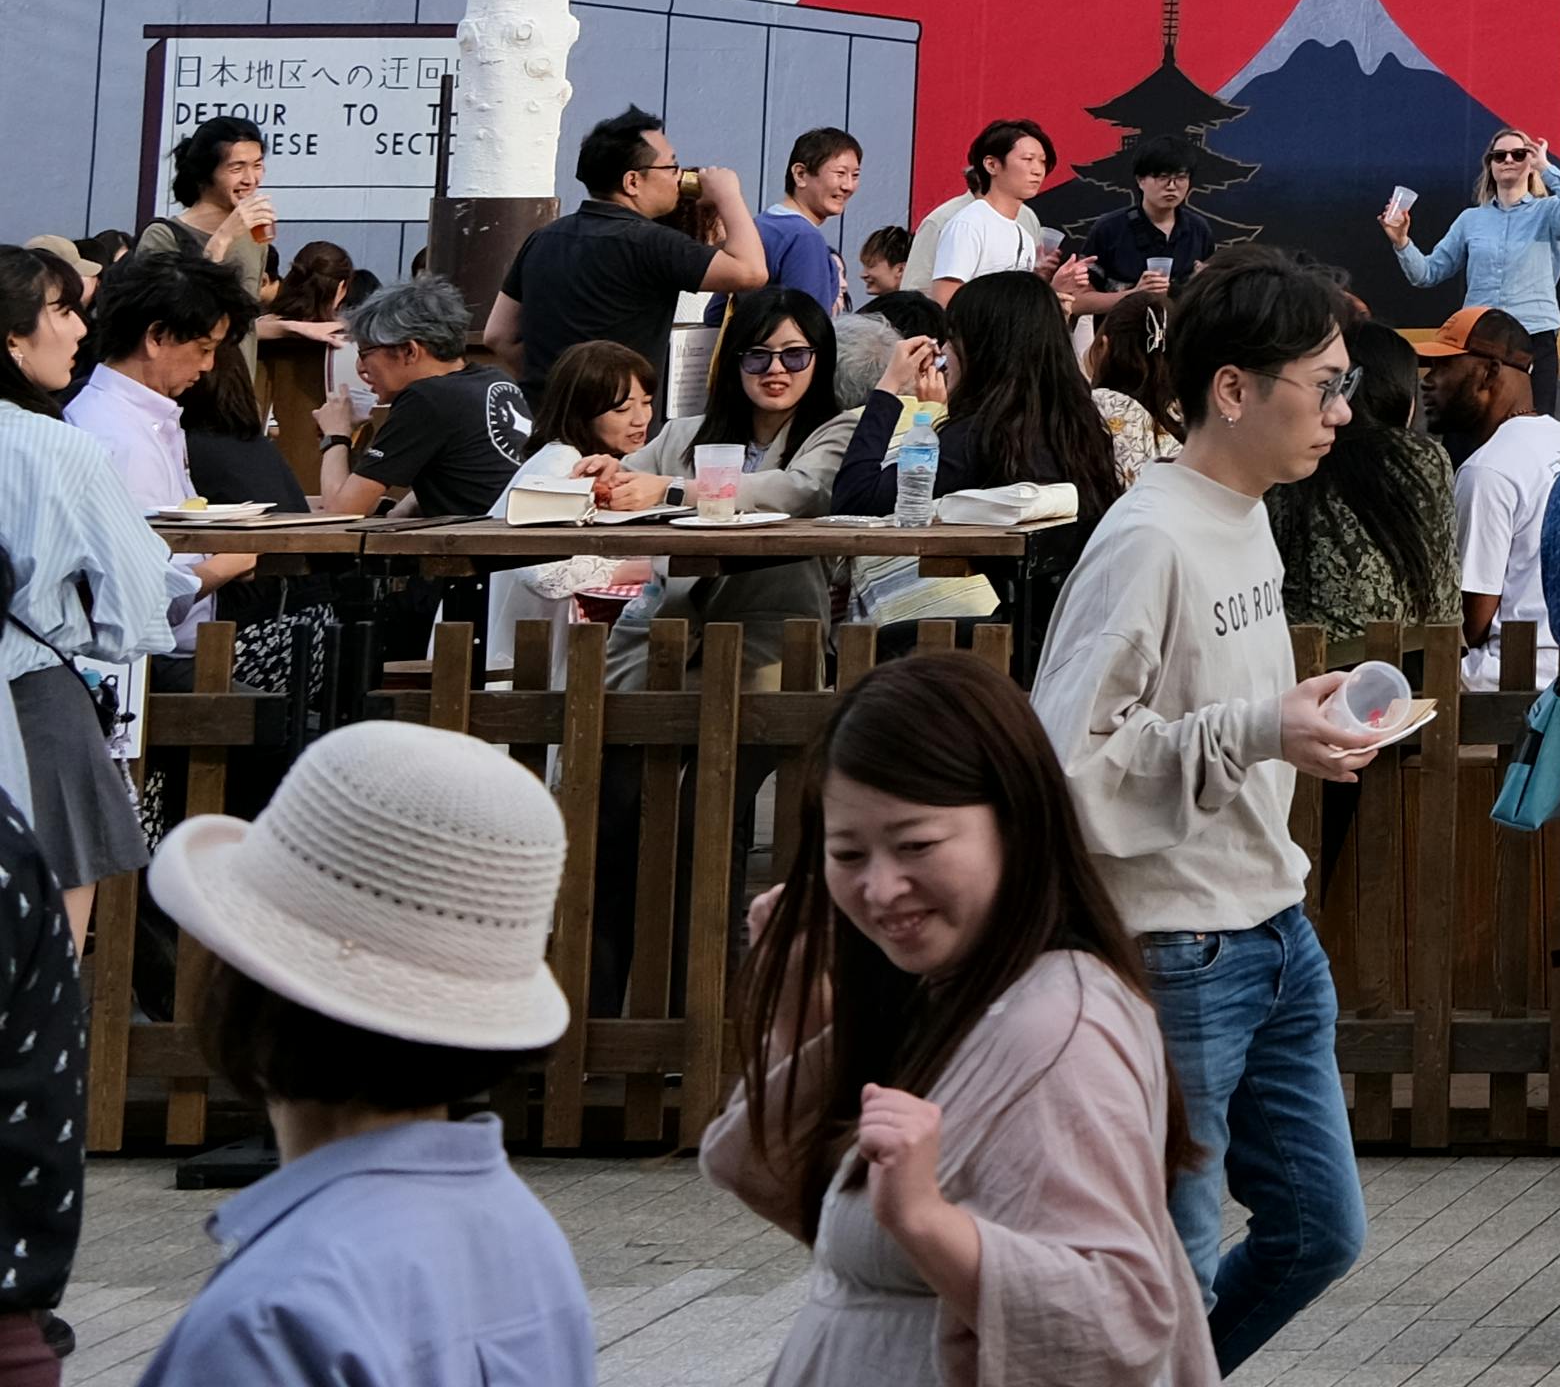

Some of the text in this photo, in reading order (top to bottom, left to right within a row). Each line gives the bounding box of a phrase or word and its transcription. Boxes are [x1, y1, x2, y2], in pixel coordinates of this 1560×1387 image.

[177, 55, 460, 90] 日本地区への迂回
[343, 103, 378, 126] TO
[375, 132, 457, 156] SECT
[1213, 592, 1249, 637] SOB
